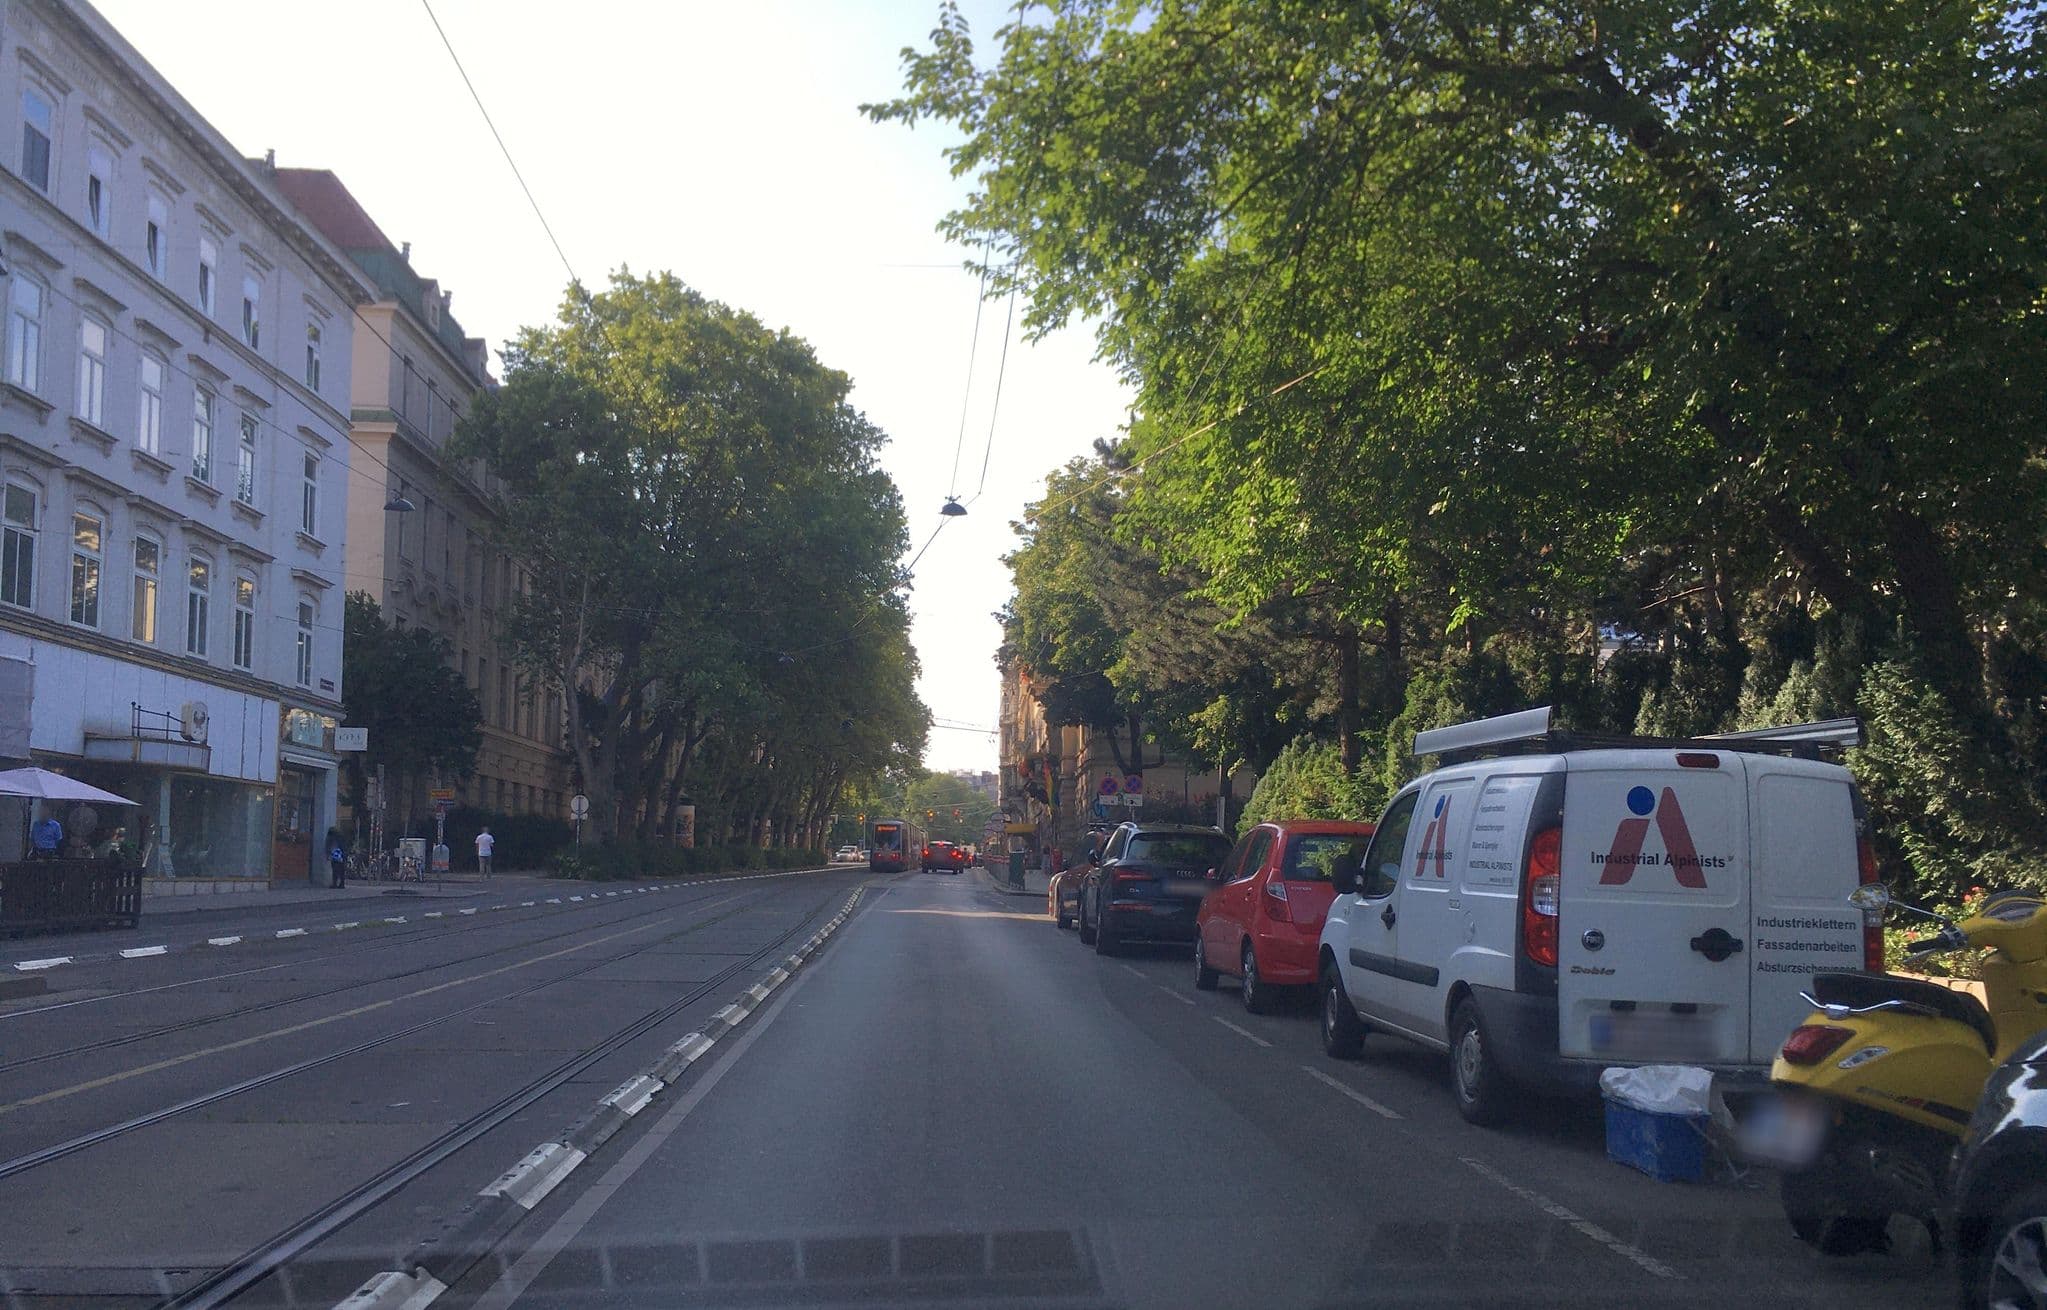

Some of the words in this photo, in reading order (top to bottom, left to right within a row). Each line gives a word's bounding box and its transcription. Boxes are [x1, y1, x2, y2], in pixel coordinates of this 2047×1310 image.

[1591, 852, 1659, 866] Industrial
[1664, 853, 1725, 868] Alpinists
[1757, 917, 1856, 930] Industrieklettern
[1757, 939, 1857, 952] Fassadenarbeiten
